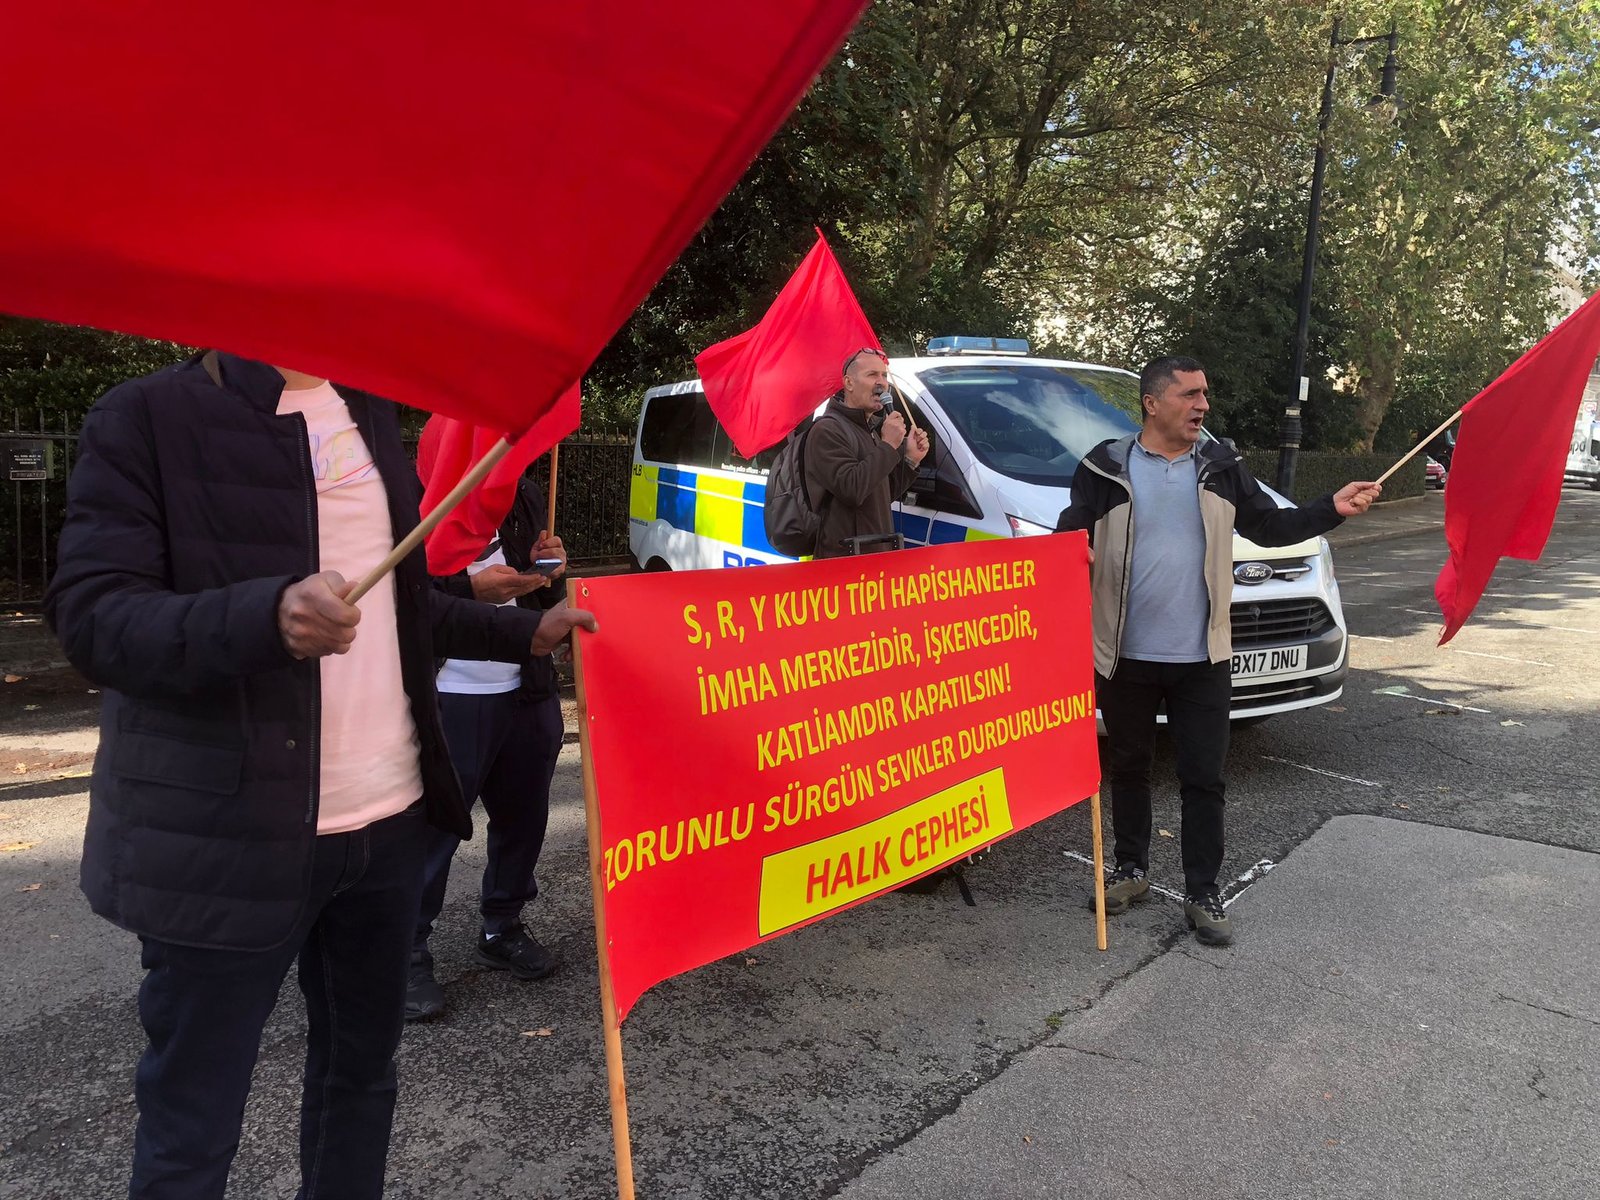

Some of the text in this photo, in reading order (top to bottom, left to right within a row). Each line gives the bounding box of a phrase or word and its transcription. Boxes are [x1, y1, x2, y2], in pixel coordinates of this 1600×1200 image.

[683, 559, 1036, 650] S, R, Y KUYU TİPİ HAPİSHANELER
[1245, 565, 1267, 577] Ford
[696, 604, 1038, 716] İMHA MERKEZİDİR, İŞKENCEDİR,
[1231, 648, 1299, 675] BX17 DNU
[757, 662, 1012, 771] KATLİAMDIR KAPATILSIN!
[604, 689, 1093, 893] ZORUNLU SÜRGÜN SEVKLER DURDURULSUN!
[806, 785, 990, 904] HALK CEPHESİ
